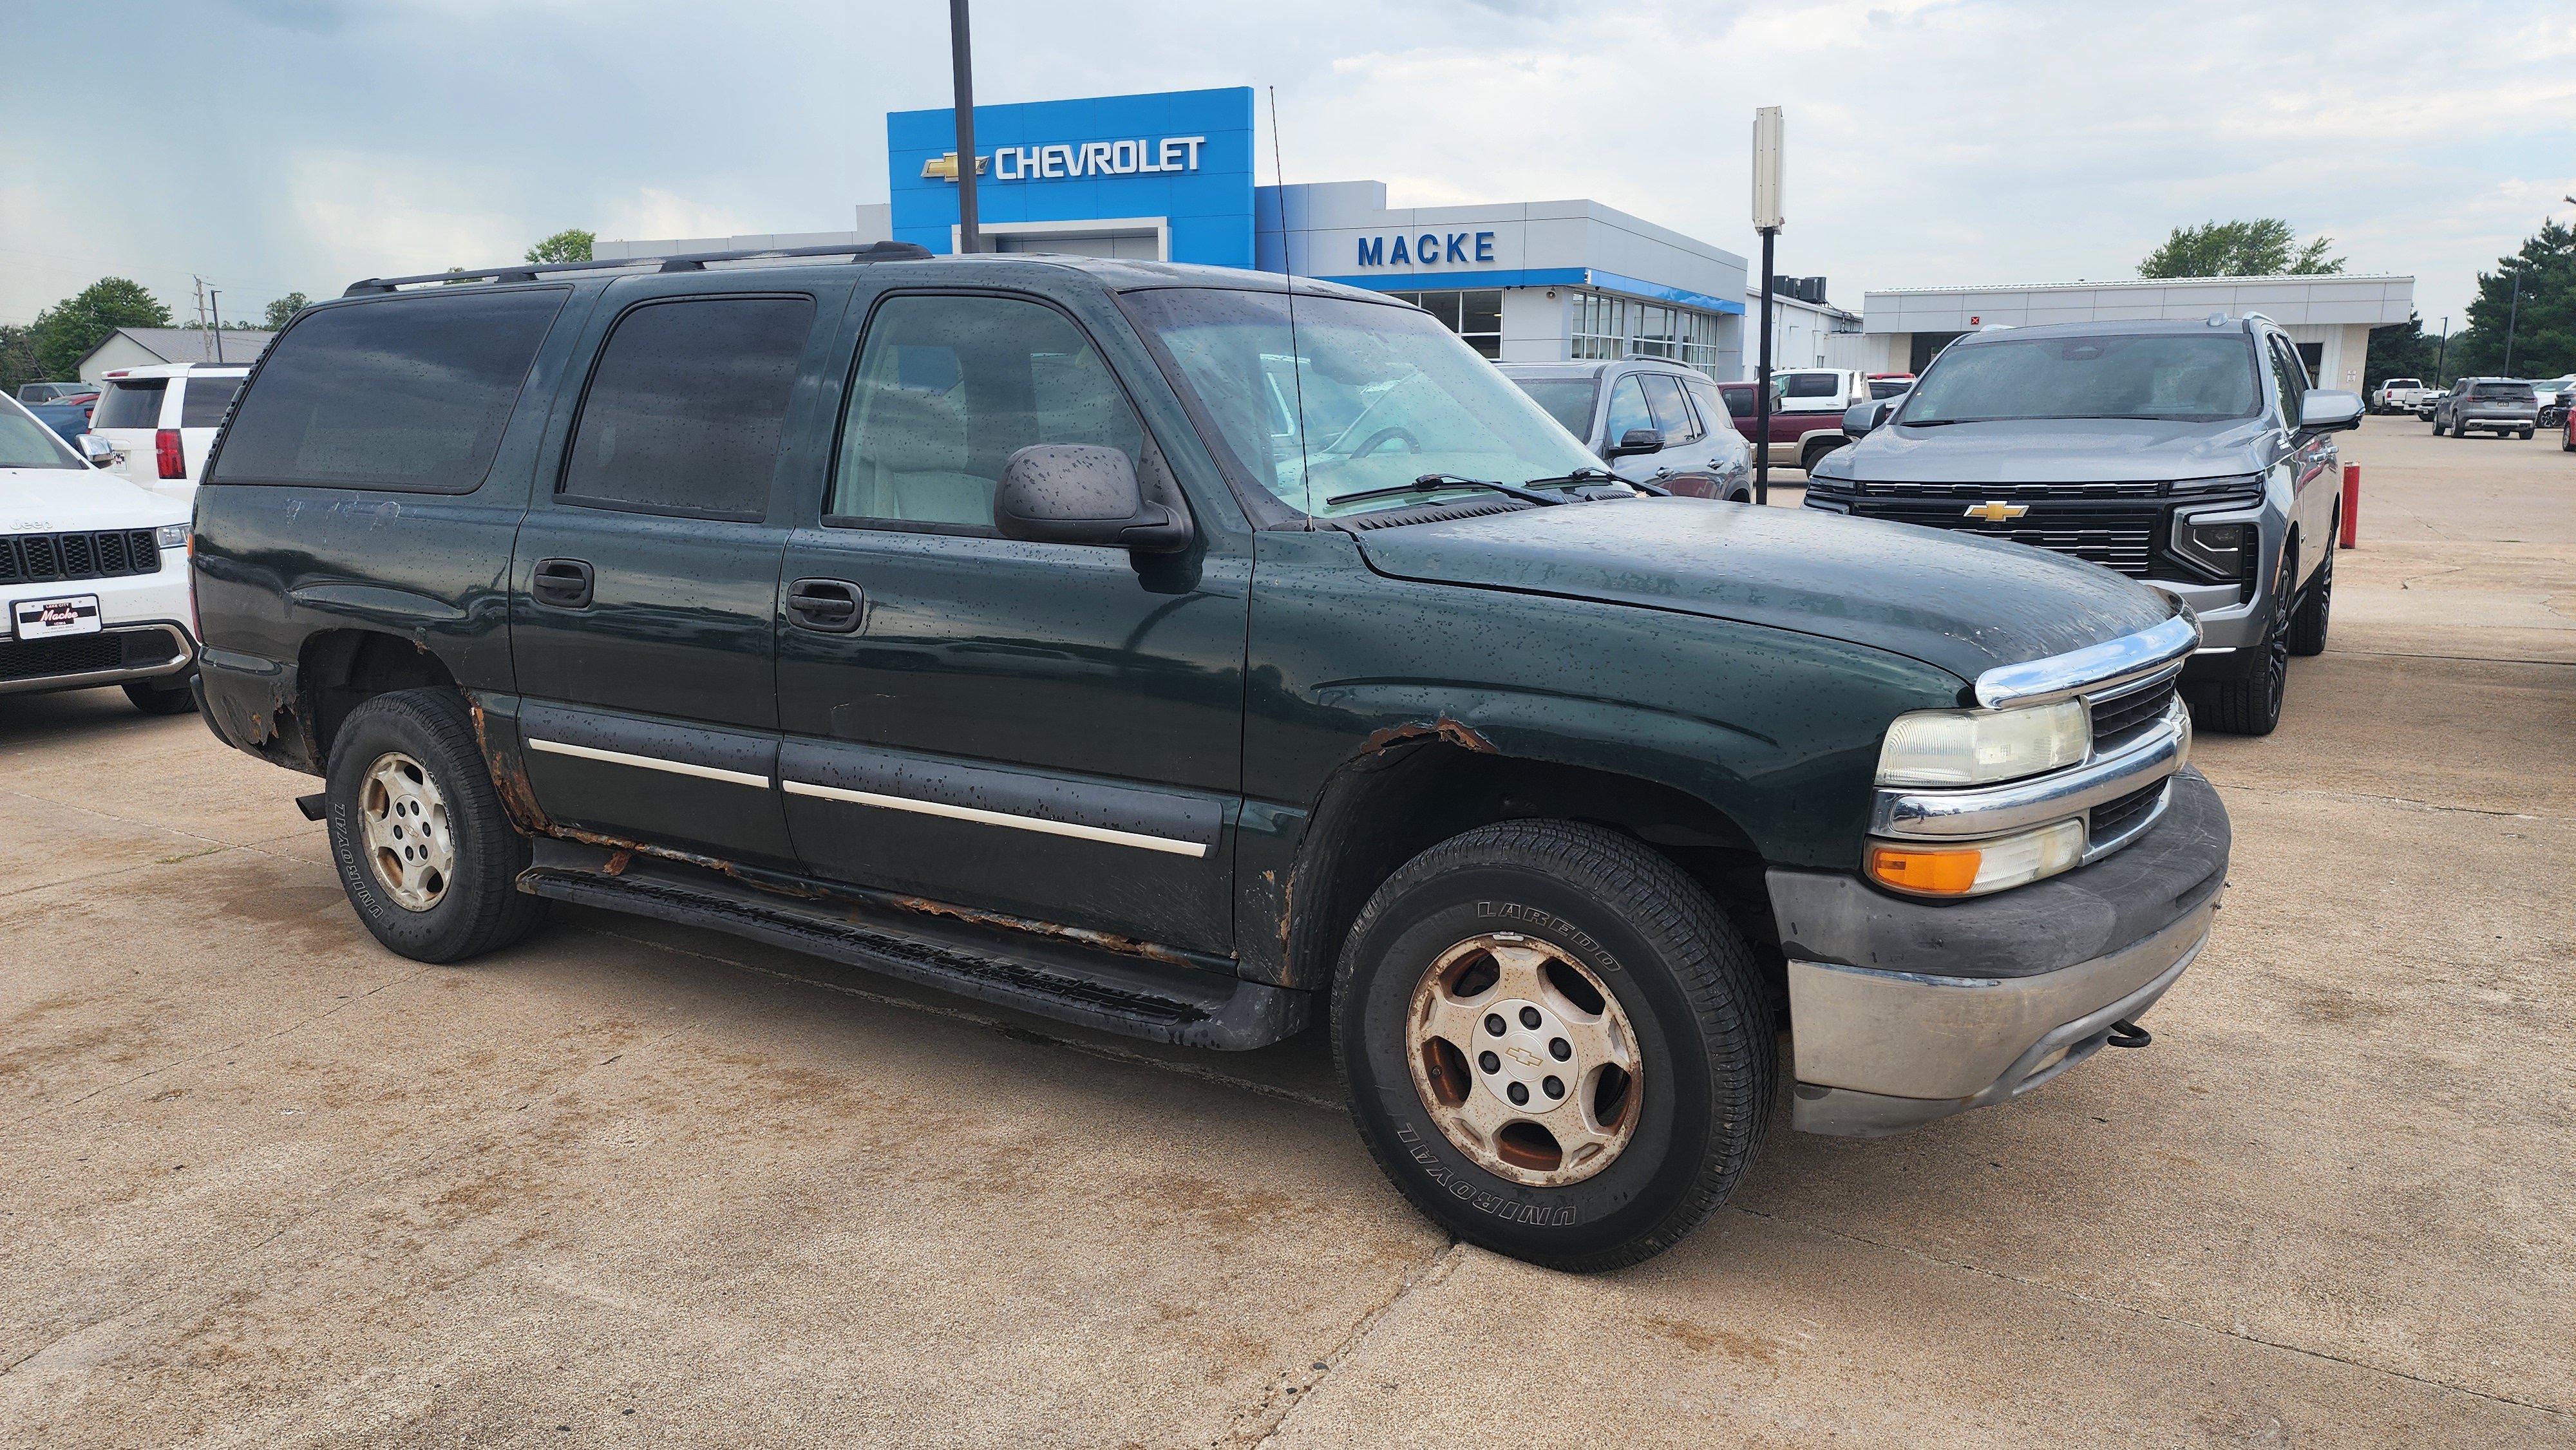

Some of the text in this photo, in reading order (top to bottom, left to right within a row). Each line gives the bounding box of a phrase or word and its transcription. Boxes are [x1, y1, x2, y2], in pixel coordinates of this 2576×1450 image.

[996, 136, 1206, 180] CHEVROLET
[1358, 231, 1495, 266] MACKE
[10, 519, 53, 531] Jeep
[39, 607, 79, 621] Macke
[334, 804, 384, 919] UNIROYAL
[1477, 901, 1621, 972] LAREDO
[1396, 1122, 1577, 1227] UNIROYAL
